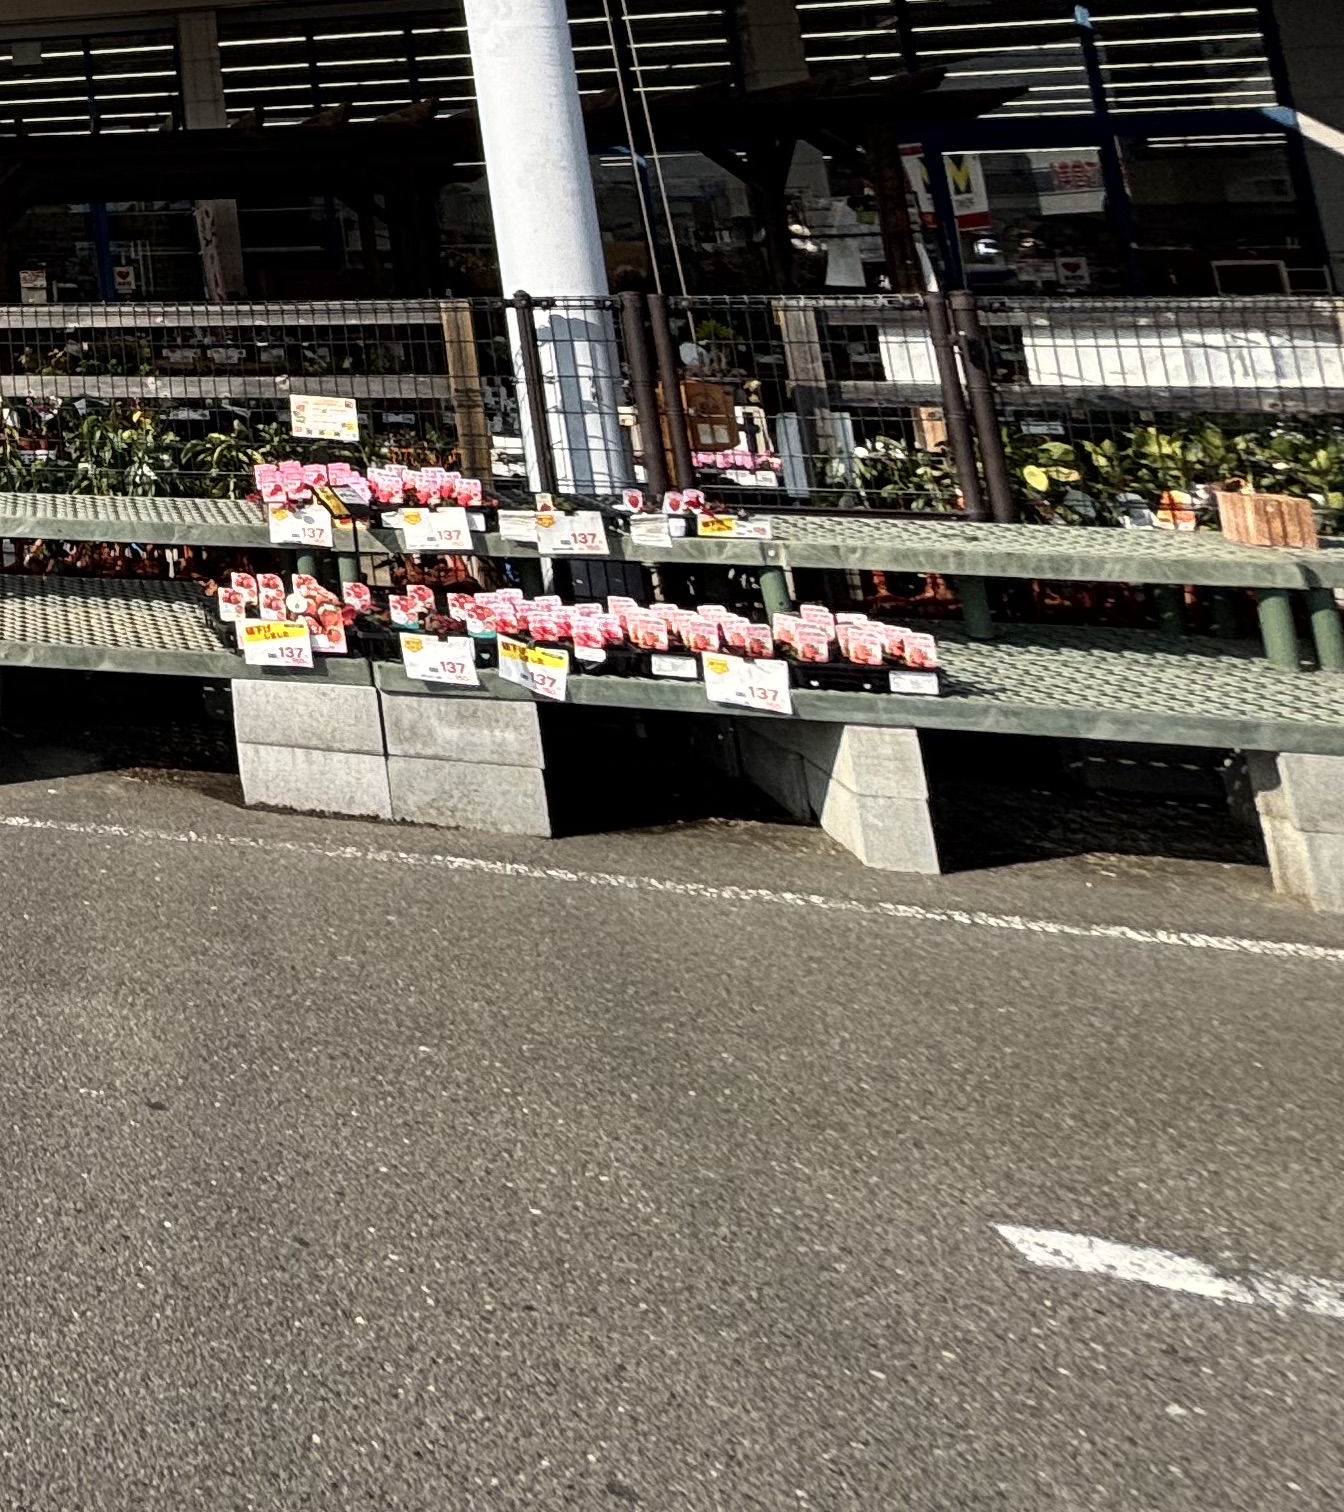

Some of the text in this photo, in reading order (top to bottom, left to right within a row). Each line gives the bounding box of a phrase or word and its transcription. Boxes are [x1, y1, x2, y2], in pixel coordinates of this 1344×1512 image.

[301, 527, 325, 539] 137
[437, 529, 462, 541] 137
[571, 532, 597, 544] 137
[278, 646, 304, 659] 137
[439, 661, 466, 675] 137
[748, 686, 779, 702] 137
